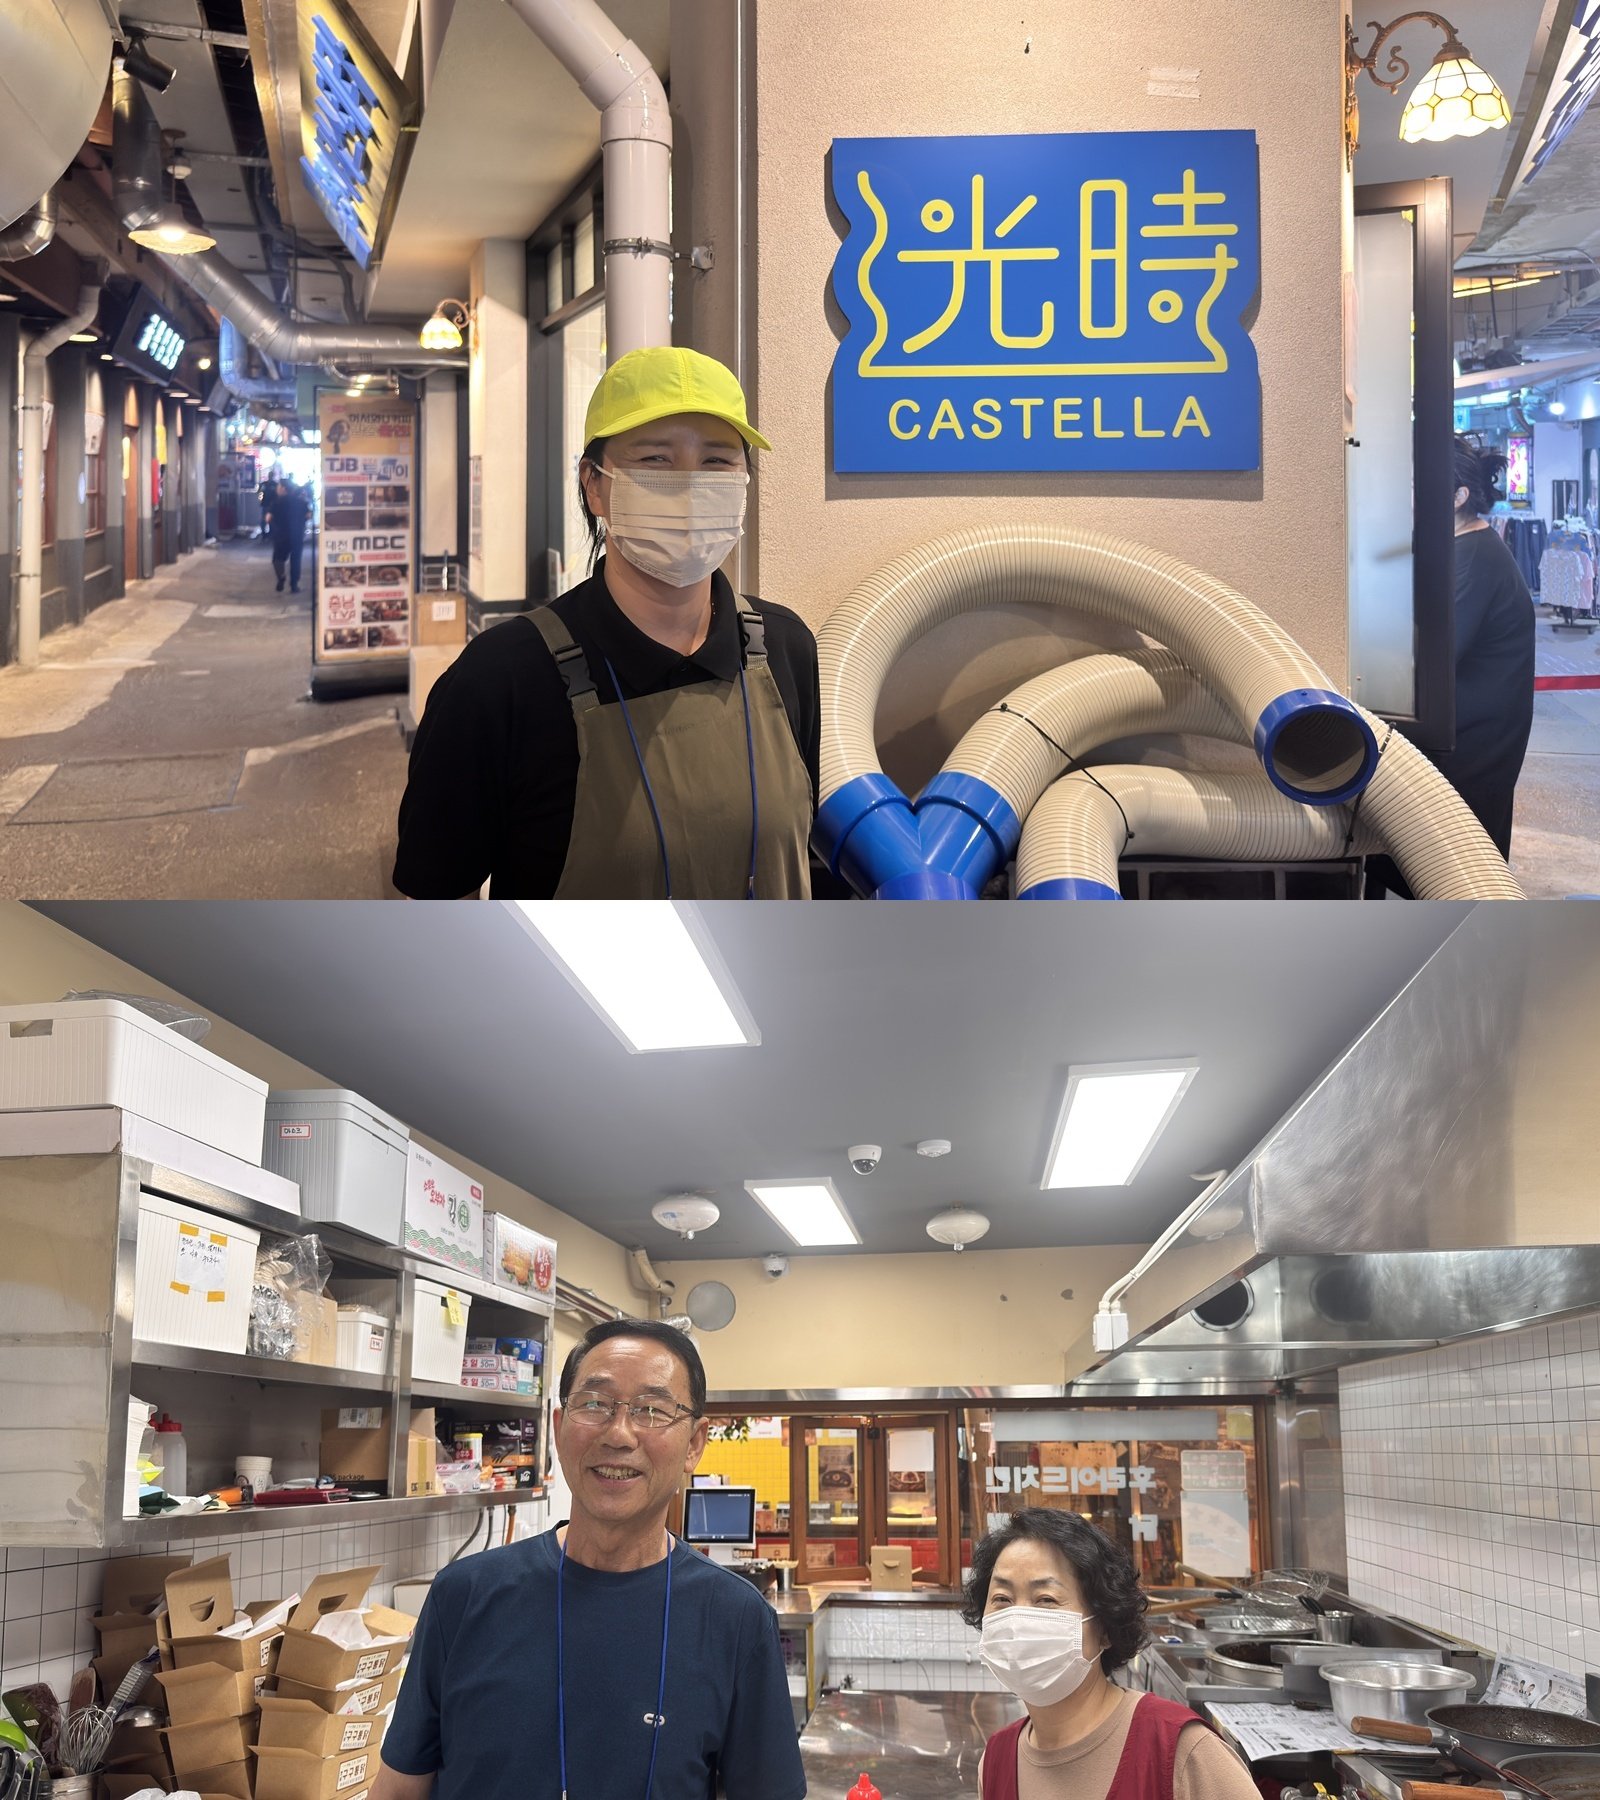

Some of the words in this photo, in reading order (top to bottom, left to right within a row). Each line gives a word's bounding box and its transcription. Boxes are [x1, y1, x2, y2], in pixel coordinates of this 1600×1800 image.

[897, 168, 1239, 355] 光時
[888, 395, 1211, 440] CASTELLA
[325, 457, 358, 472] TJB
[353, 535, 405, 550] MBC
